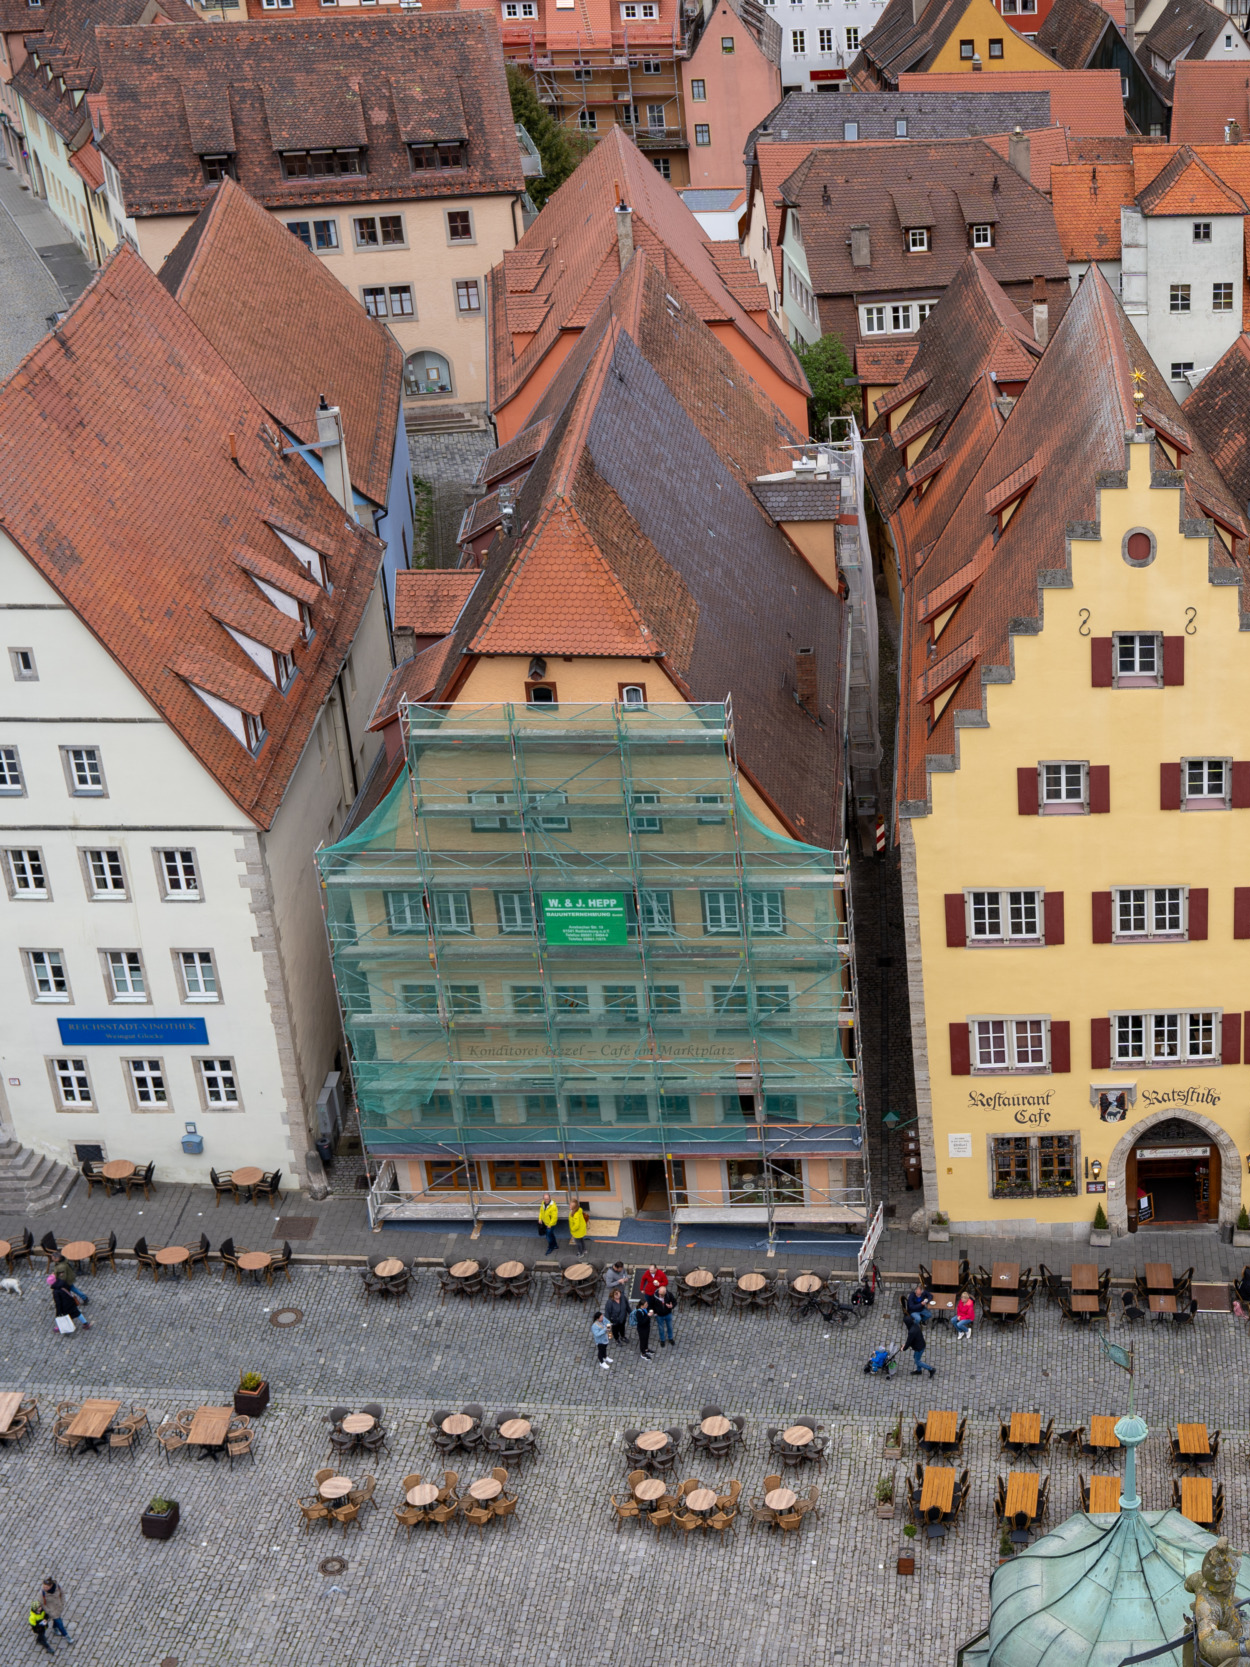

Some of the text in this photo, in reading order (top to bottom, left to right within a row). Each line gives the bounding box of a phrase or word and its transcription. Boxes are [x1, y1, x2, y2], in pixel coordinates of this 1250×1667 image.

[548, 899, 617, 907] W. & J. HEPP
[68, 1023, 197, 1031] REICHSSTADT-VINOTHEK
[467, 1045, 538, 1058] Konditorei
[601, 1044, 630, 1057] Café
[659, 1044, 735, 1057] Marktplatz
